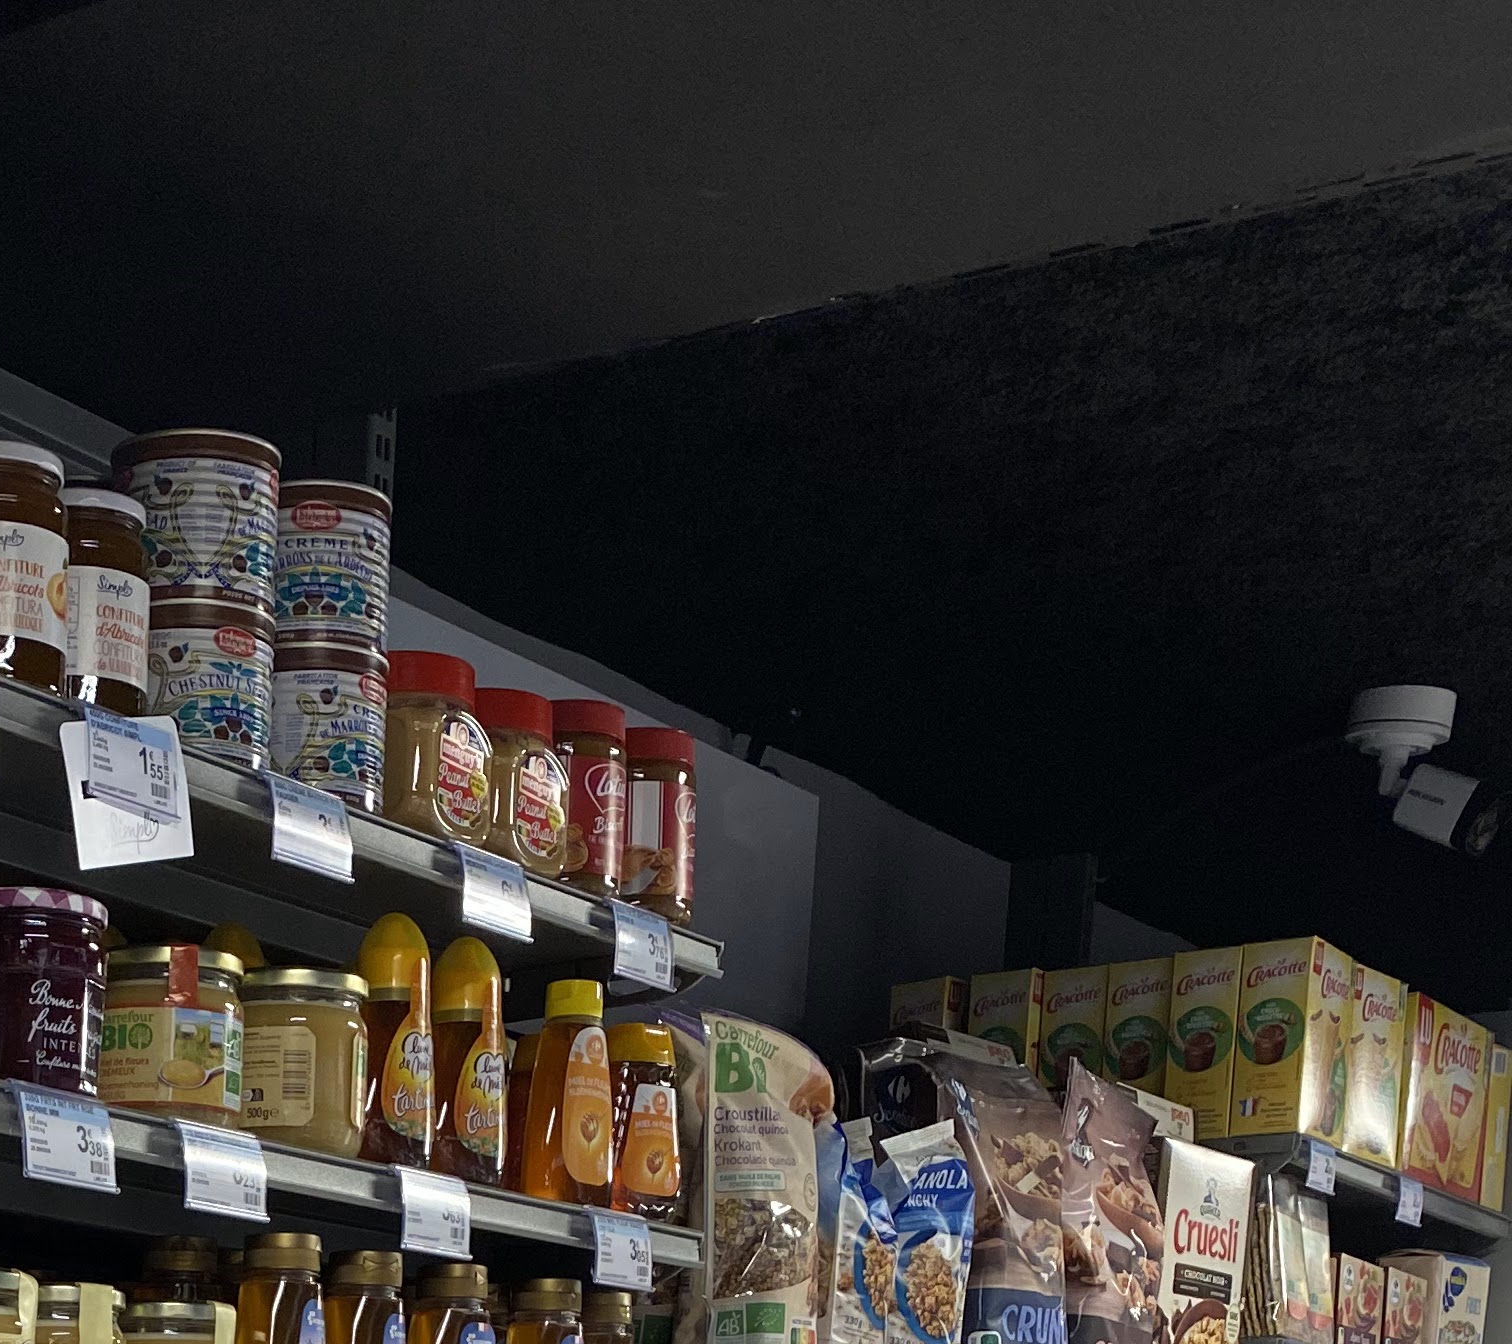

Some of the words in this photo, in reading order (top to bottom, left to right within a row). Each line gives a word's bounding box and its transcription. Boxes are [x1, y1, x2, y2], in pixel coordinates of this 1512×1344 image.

[29, 1014, 77, 1042] fruits
[715, 1020, 780, 1061] Carrefour
[714, 1137, 763, 1153] Krokant
[1174, 1208, 1239, 1264] Cruesli
